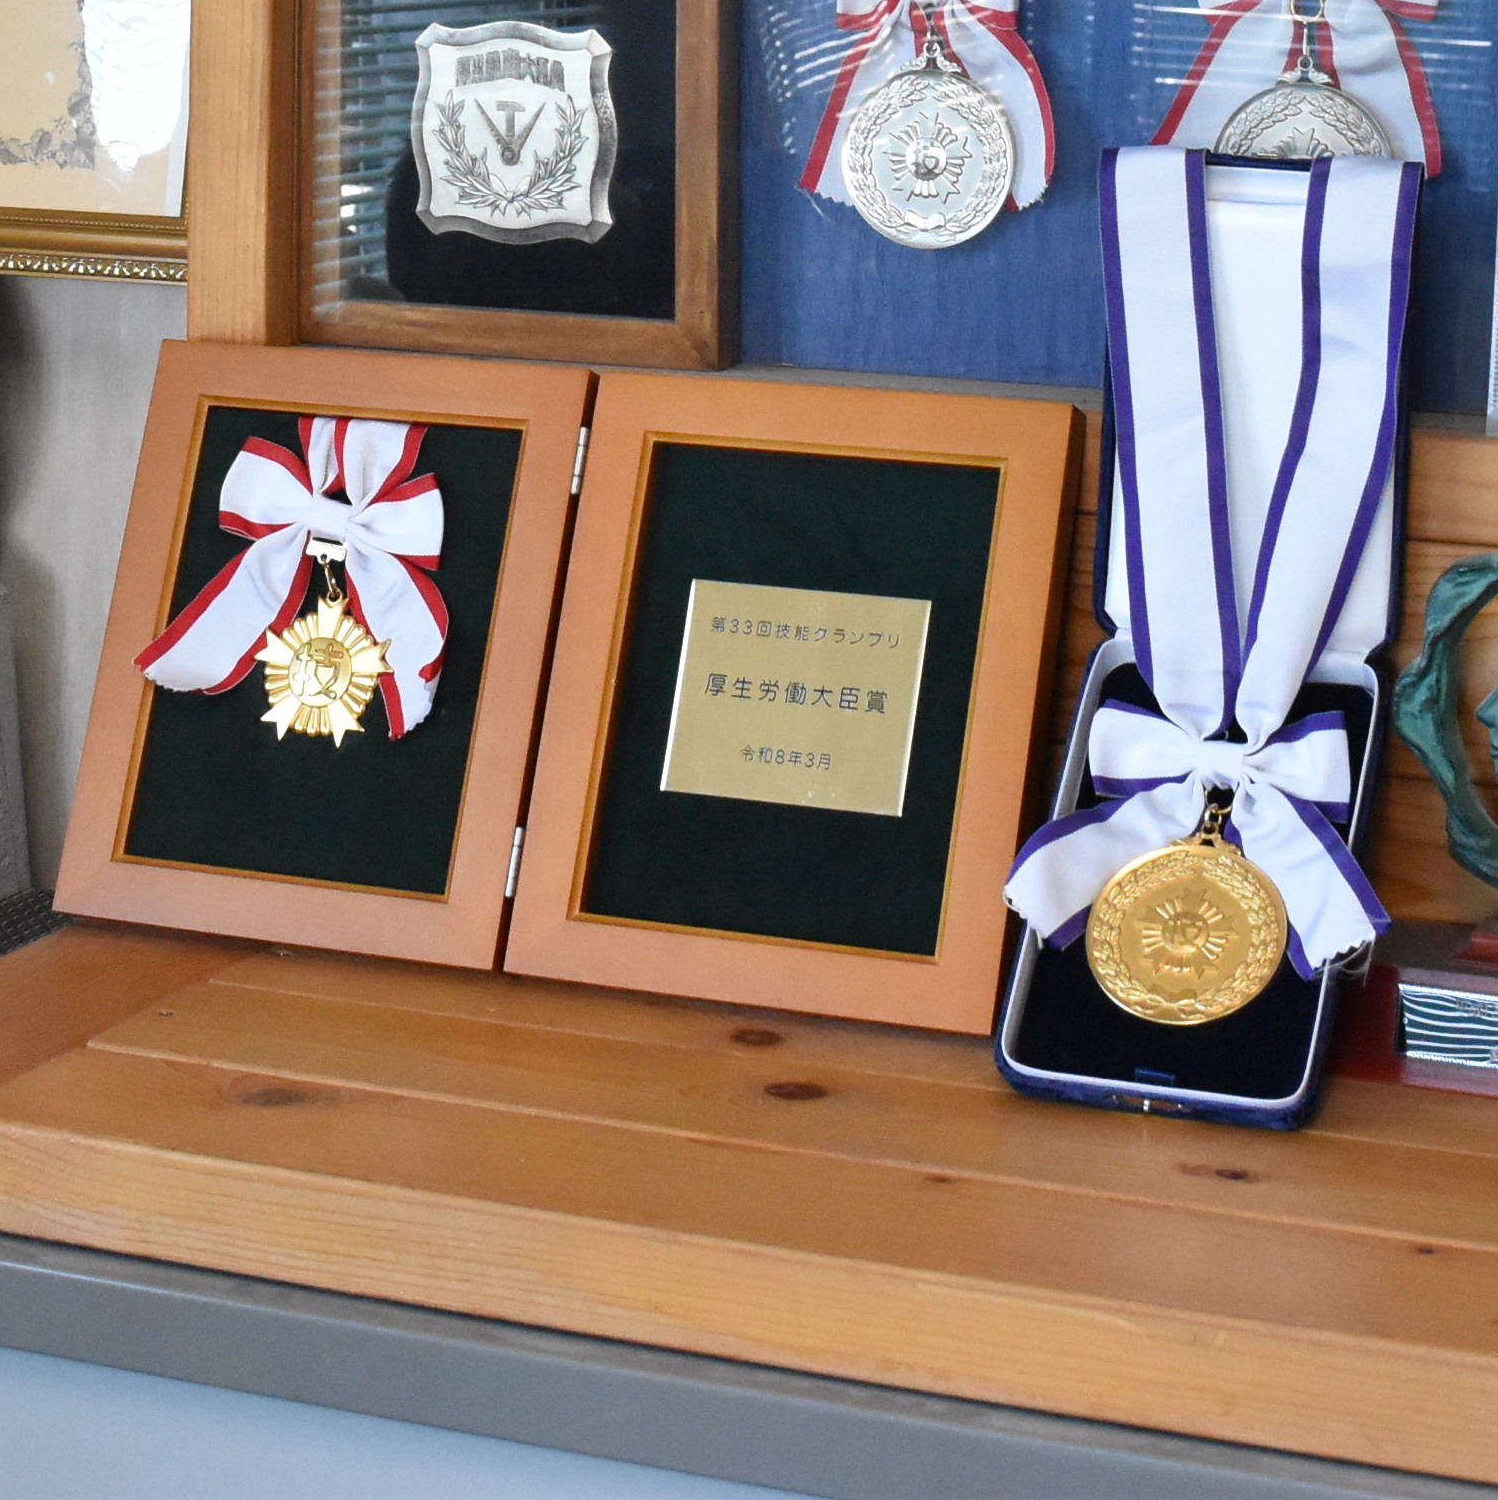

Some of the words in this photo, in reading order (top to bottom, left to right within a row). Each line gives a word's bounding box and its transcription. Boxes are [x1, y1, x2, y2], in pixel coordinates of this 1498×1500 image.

[704, 673, 889, 715] 厚生労働大臣賞
[741, 745, 832, 771] 令和8年3月
